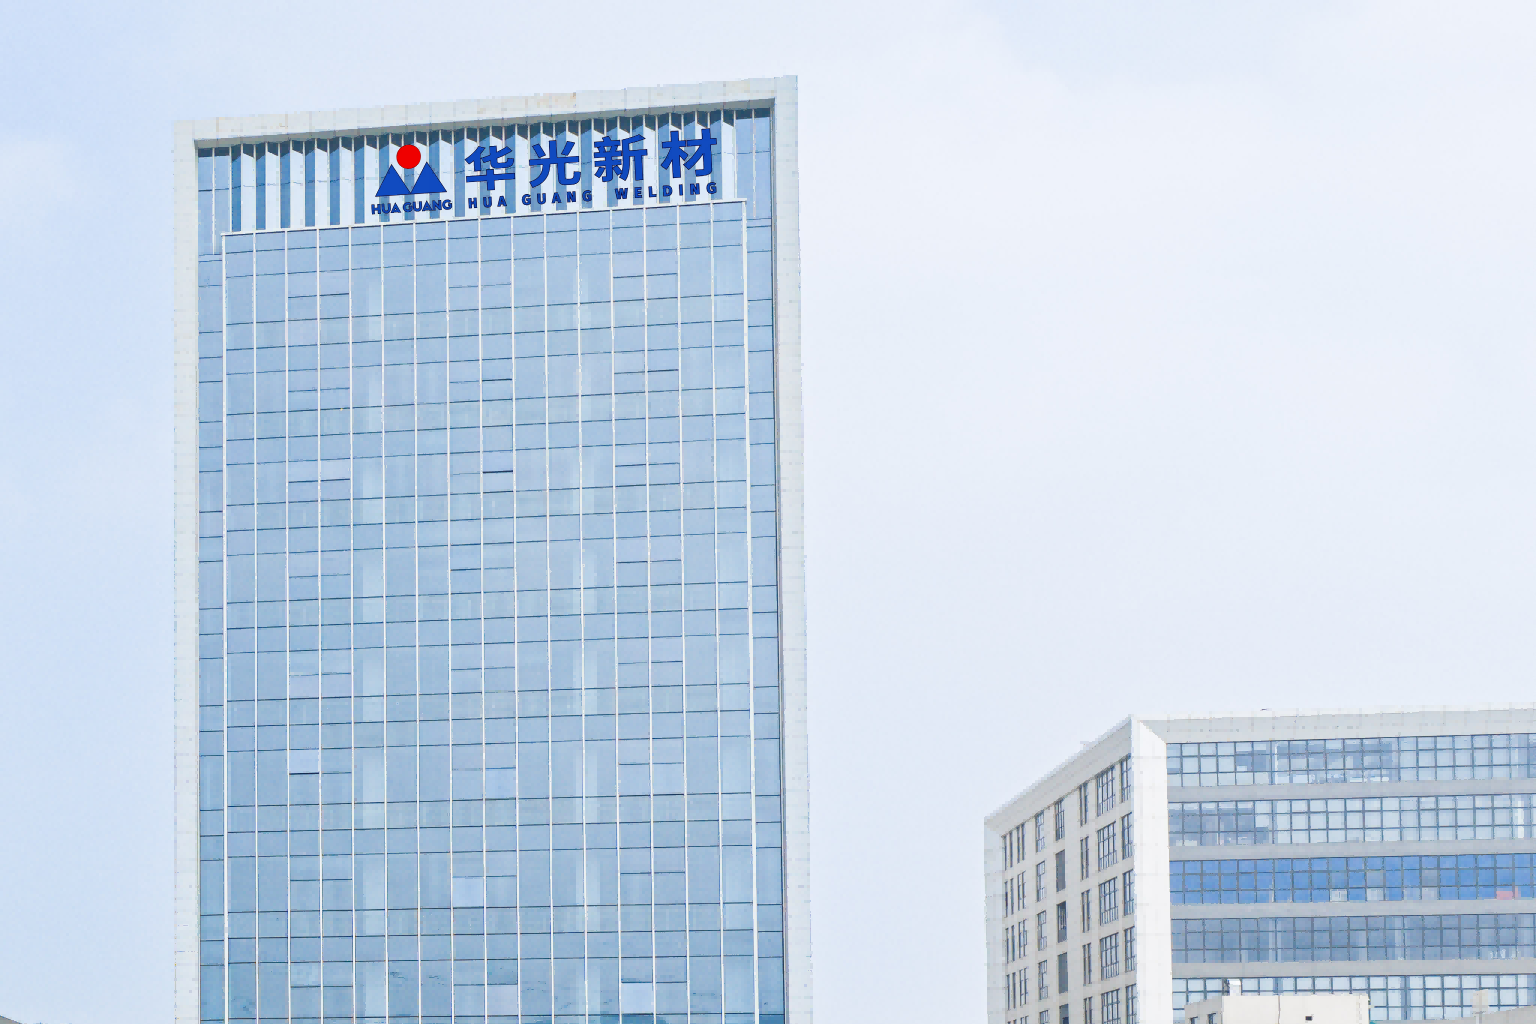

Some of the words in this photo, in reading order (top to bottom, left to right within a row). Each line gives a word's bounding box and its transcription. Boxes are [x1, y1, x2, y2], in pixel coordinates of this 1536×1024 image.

[464, 128, 718, 191] 华光新材
[371, 202, 401, 215] HUA
[403, 199, 453, 213] GUANG
[468, 195, 508, 209] HUA
[521, 189, 594, 206] GUANG
[614, 181, 718, 200] WELDING
